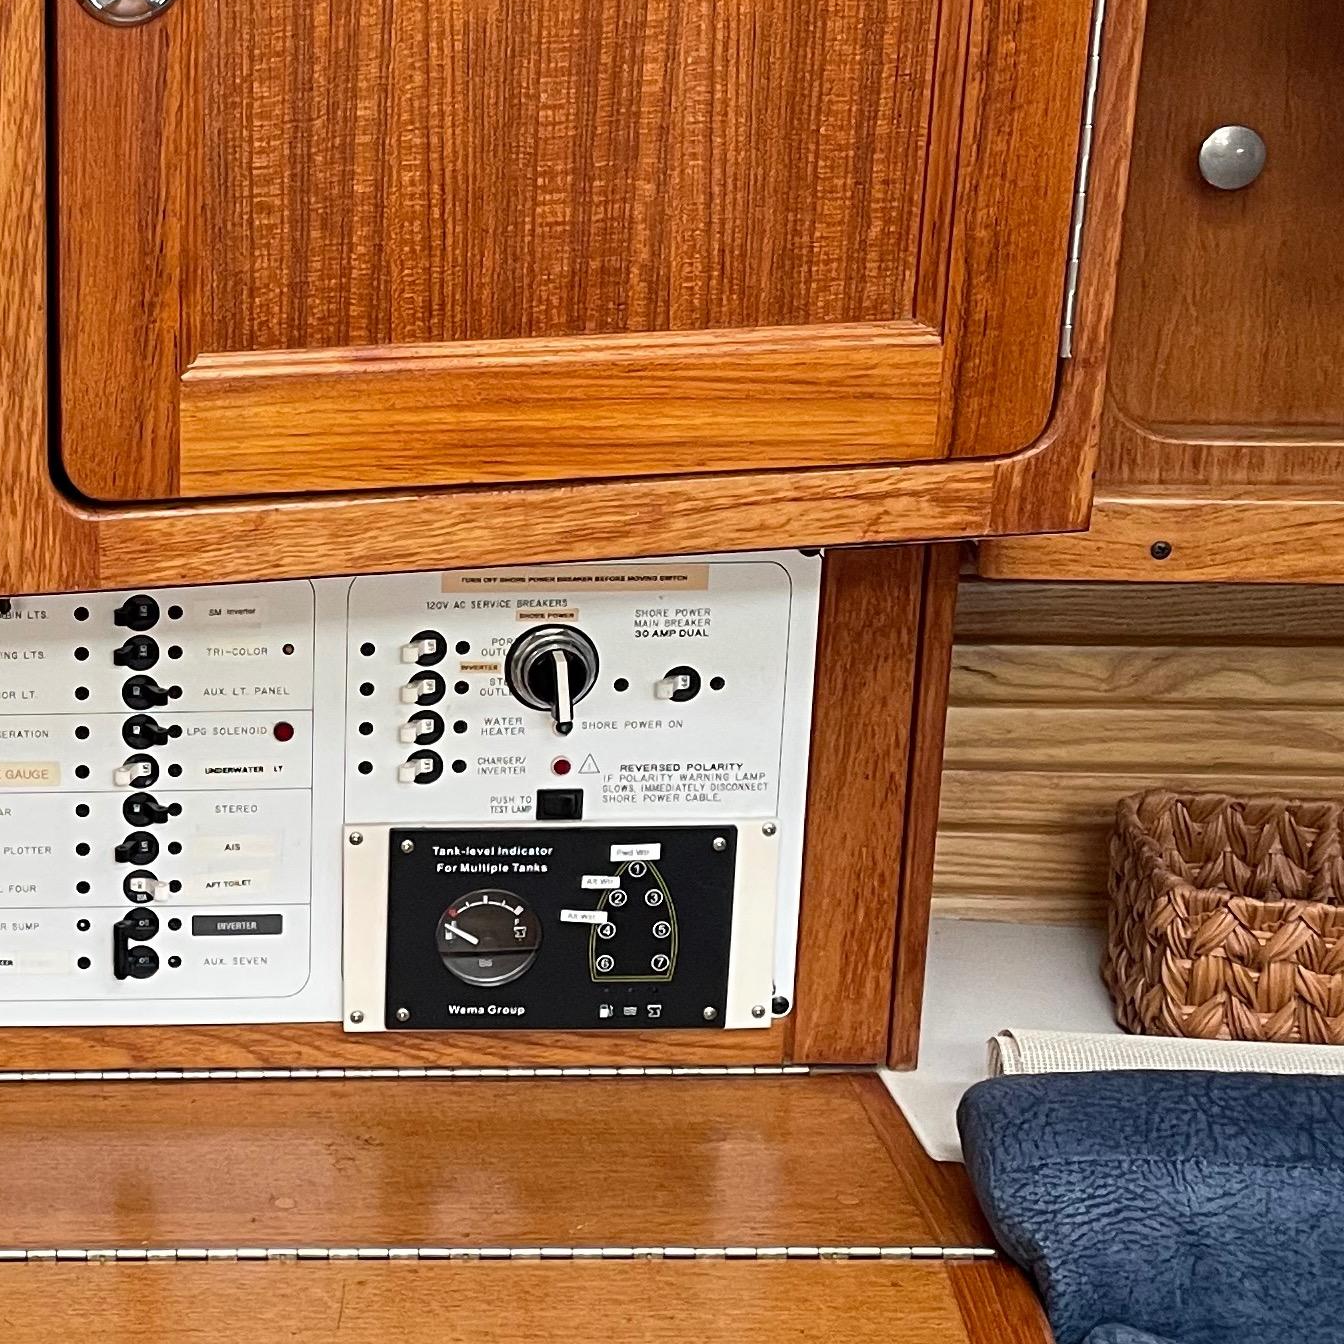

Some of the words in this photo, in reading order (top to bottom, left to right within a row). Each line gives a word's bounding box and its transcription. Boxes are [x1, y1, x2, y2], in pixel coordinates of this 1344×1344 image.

[426, 601, 450, 610] 120V
[453, 600, 466, 609] AC
[471, 599, 511, 609] SERVICE
[517, 598, 568, 608] BREAKERS
[635, 609, 669, 618] SHORE
[675, 608, 712, 617] POWER
[634, 619, 659, 627] MAIN
[665, 618, 712, 627] BREAKER
[635, 629, 649, 638] 30
[652, 629, 676, 638] AMP
[679, 629, 709, 637] DUAL
[491, 638, 514, 646] POR
[206, 647, 268, 656] TRI-COLOR
[254, 687, 290, 695] PANEL
[484, 717, 523, 726] WATER
[581, 721, 618, 730] SHORE
[624, 721, 662, 729] POWER
[668, 720, 684, 728] ON
[187, 728, 206, 736] LPG
[213, 727, 267, 735] SOLENOID
[481, 727, 526, 736] HEATER
[477, 766, 526, 775] INVERTER
[620, 764, 680, 772] REVERSED
[686, 763, 743, 771] POLARITY
[5, 769, 49, 779] GAUGE
[603, 774, 613, 783] IF
[619, 774, 674, 782] POLARITY
[679, 773, 729, 782] WARNING
[735, 773, 766, 781] LAMP
[641, 784, 705, 792] IMMEDIATELY
[710, 783, 768, 792] DISCONNECT
[490, 796, 515, 804] PUSH
[602, 794, 637, 803] SHORE
[643, 794, 680, 802] POWER
[215, 805, 258, 814] STEREO
[511, 805, 532, 813] LAMP
[4, 847, 52, 855] PLOTTER
[432, 846, 495, 856] Tank-level
[497, 846, 554, 856] Indicator
[436, 863, 457, 873] For
[460, 863, 509, 874] Multiple
[512, 863, 548, 872] Tanks
[12, 923, 40, 931] SUMP
[233, 957, 268, 965] SEVEN
[448, 1005, 485, 1014] Wema
[487, 1005, 525, 1016] Group
